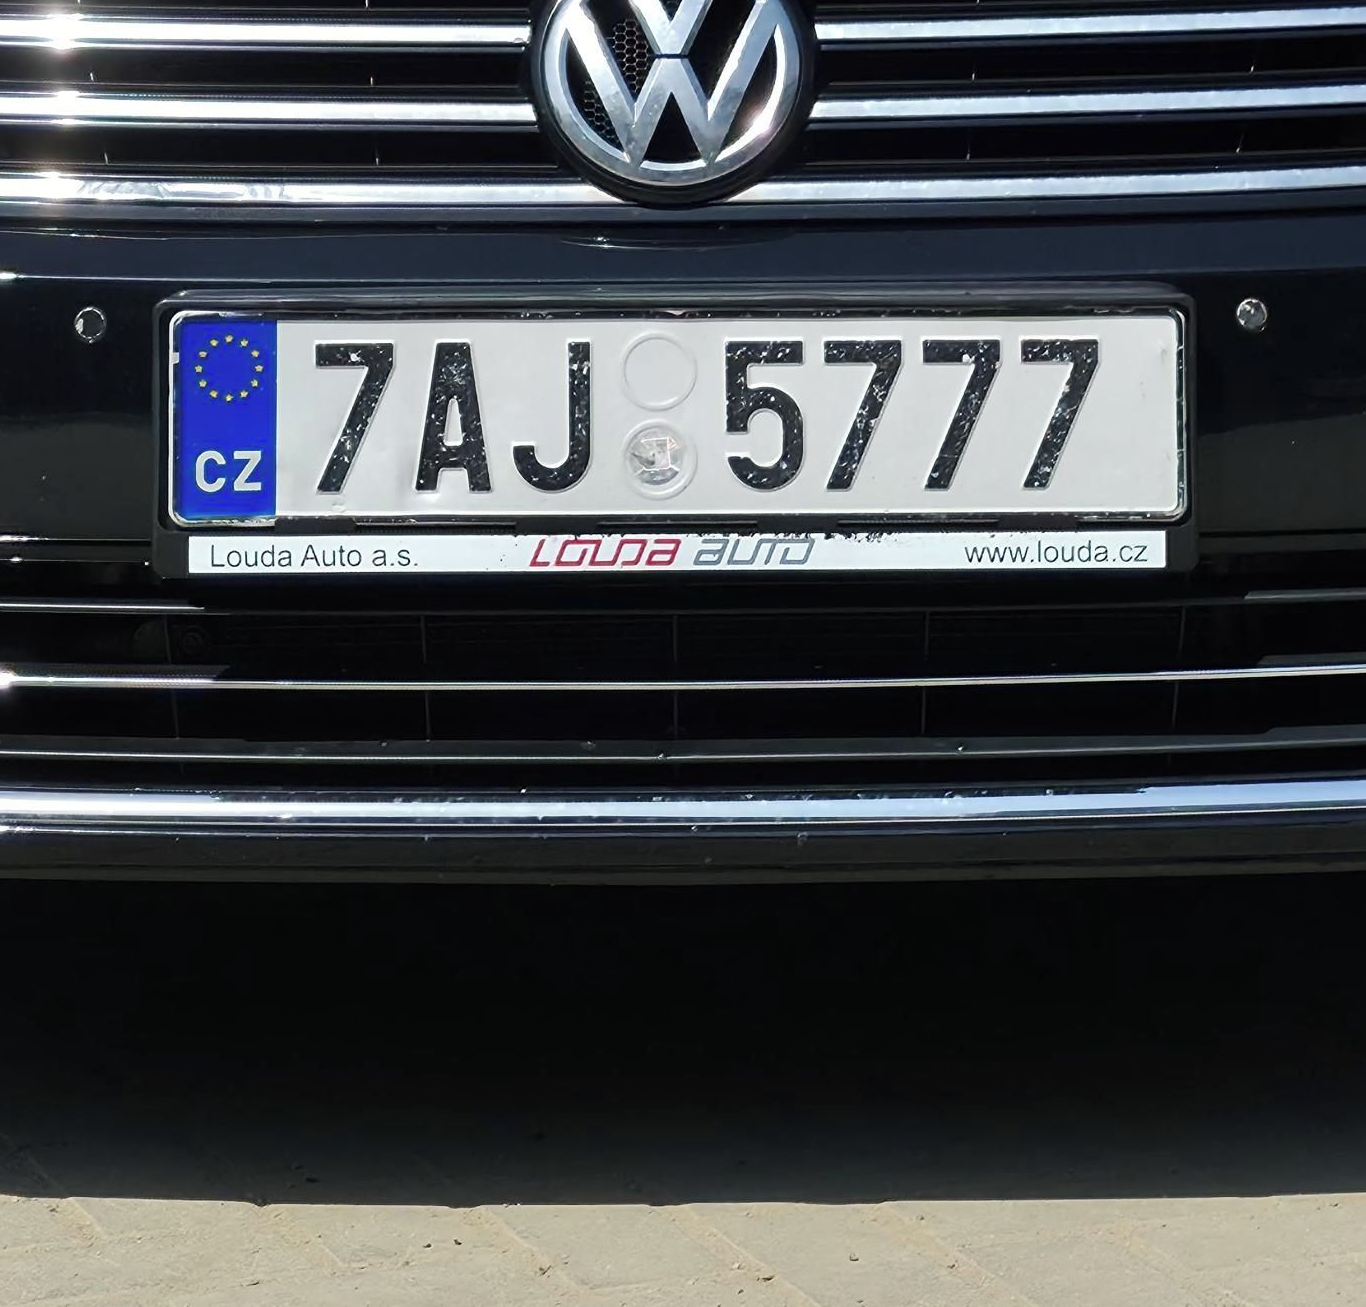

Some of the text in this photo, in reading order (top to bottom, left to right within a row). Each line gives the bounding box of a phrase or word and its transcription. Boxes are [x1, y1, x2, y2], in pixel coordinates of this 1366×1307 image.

[315, 338, 1100, 493] 7AJ 5777
[195, 450, 263, 492] CZ
[210, 544, 419, 568] Louda Auto a.s.
[964, 540, 1149, 564] www.louda.cz
